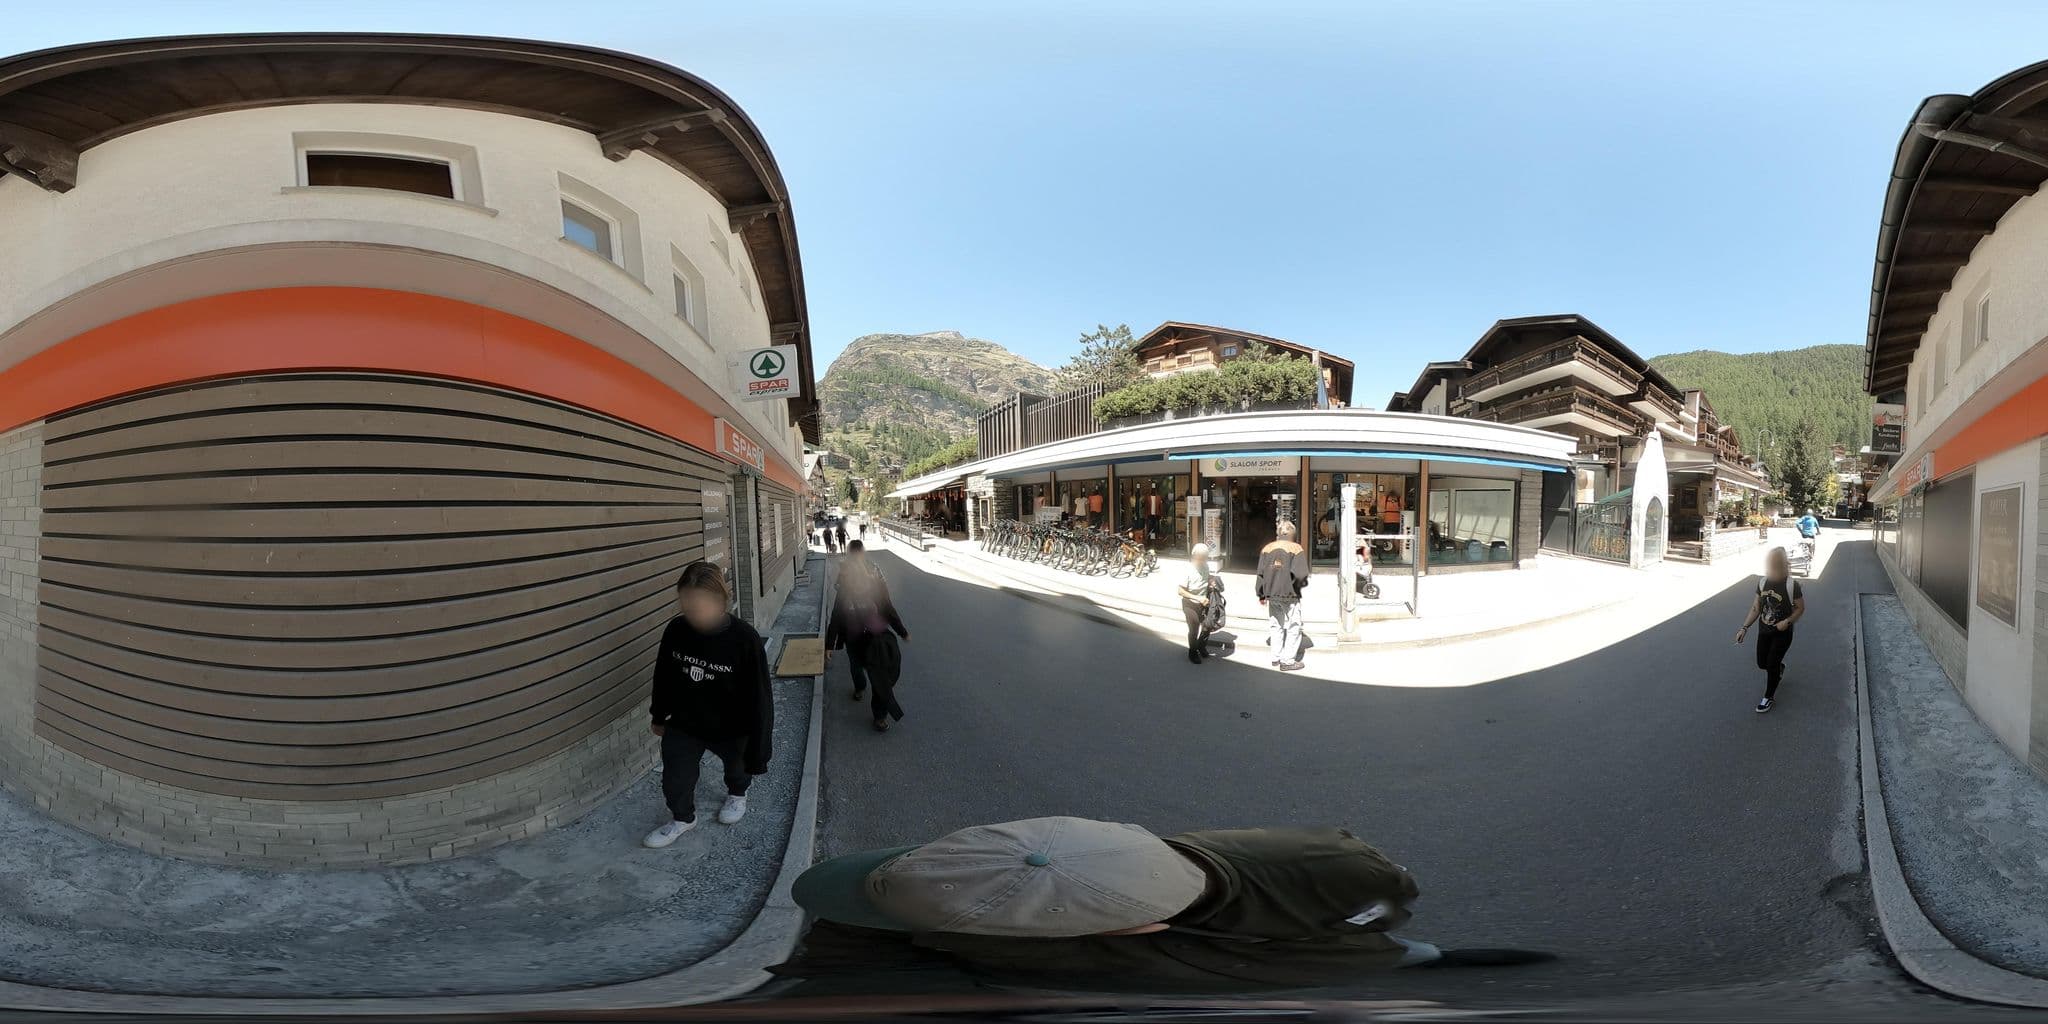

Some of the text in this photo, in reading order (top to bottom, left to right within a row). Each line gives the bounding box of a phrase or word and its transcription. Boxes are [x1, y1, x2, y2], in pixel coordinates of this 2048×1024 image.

[750, 380, 788, 390] SPAR
[732, 432, 757, 459] SPAR
[683, 655, 707, 667] POLO
[708, 663, 733, 673] ASSN.
